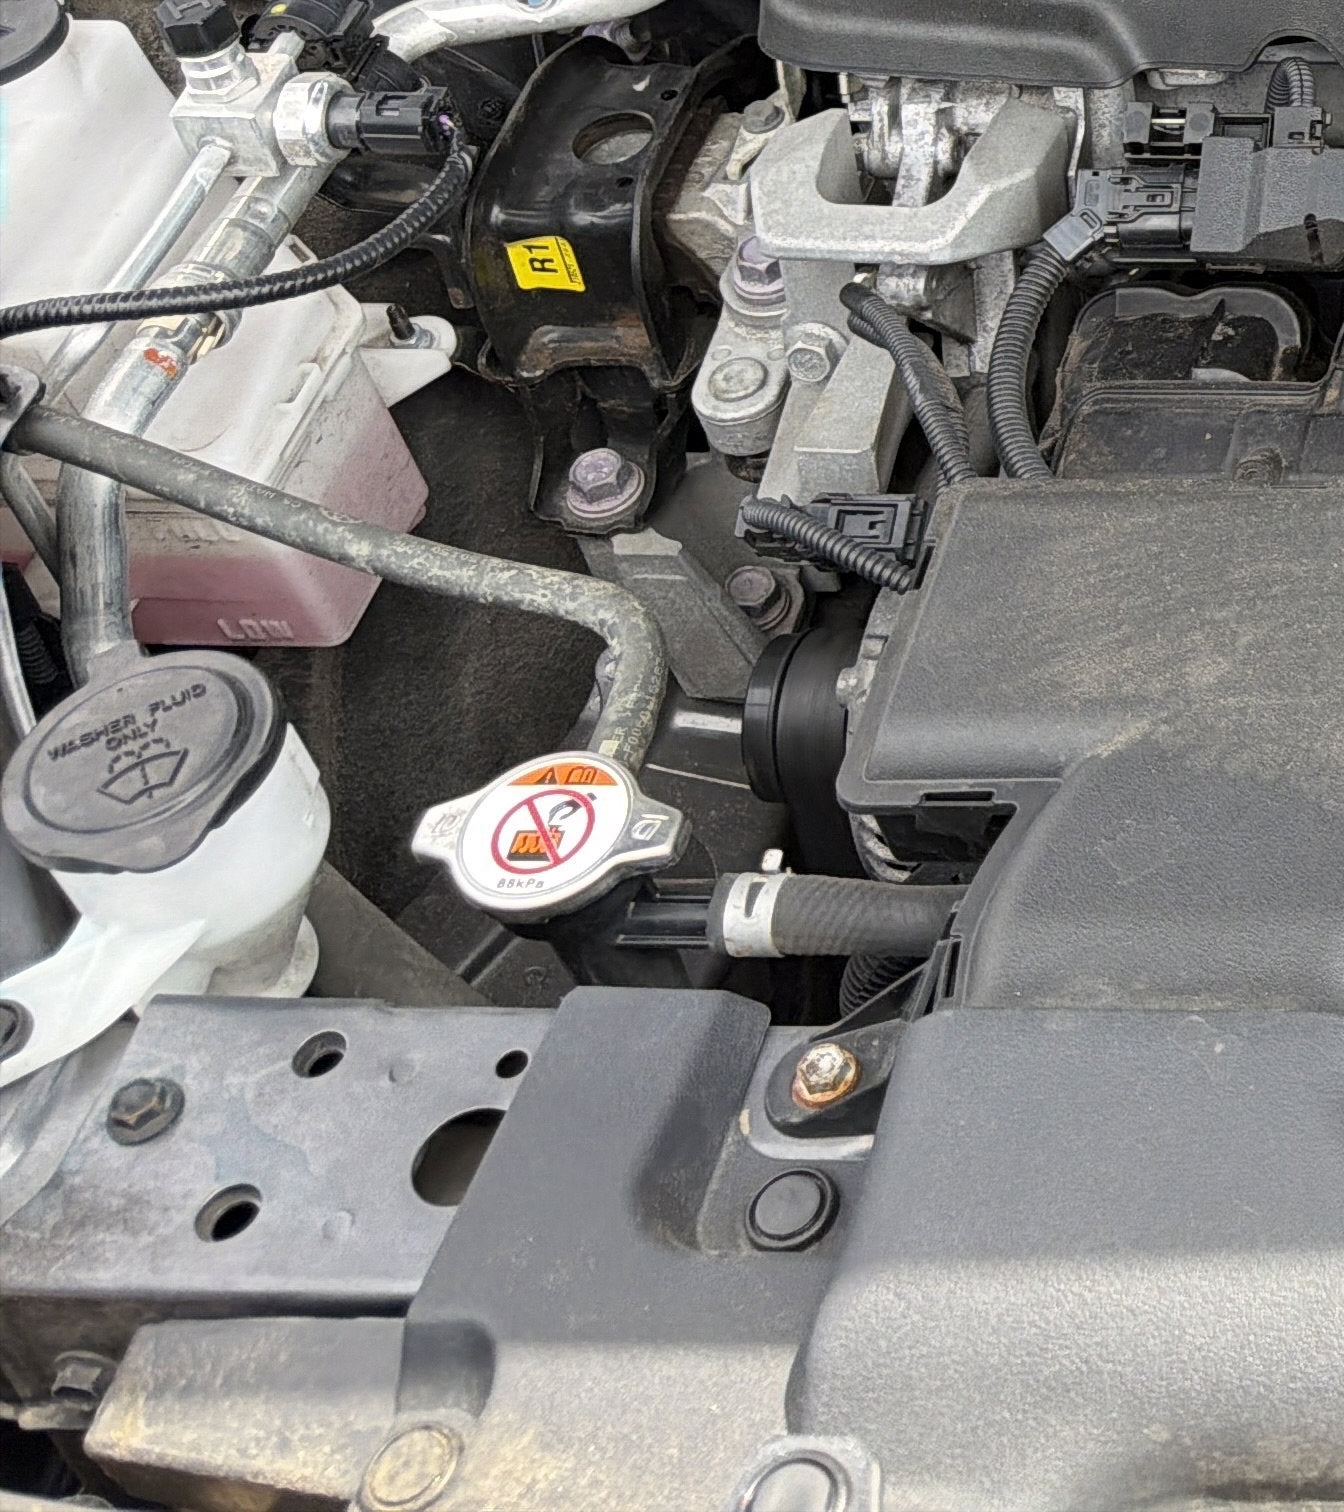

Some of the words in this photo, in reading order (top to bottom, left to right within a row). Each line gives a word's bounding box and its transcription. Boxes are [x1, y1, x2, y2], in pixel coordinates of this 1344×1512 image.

[522, 244, 559, 274] R1
[216, 618, 295, 641] LOW
[48, 714, 137, 761] WASHER
[149, 683, 207, 717] FLUID
[105, 718, 158, 752] ONLY
